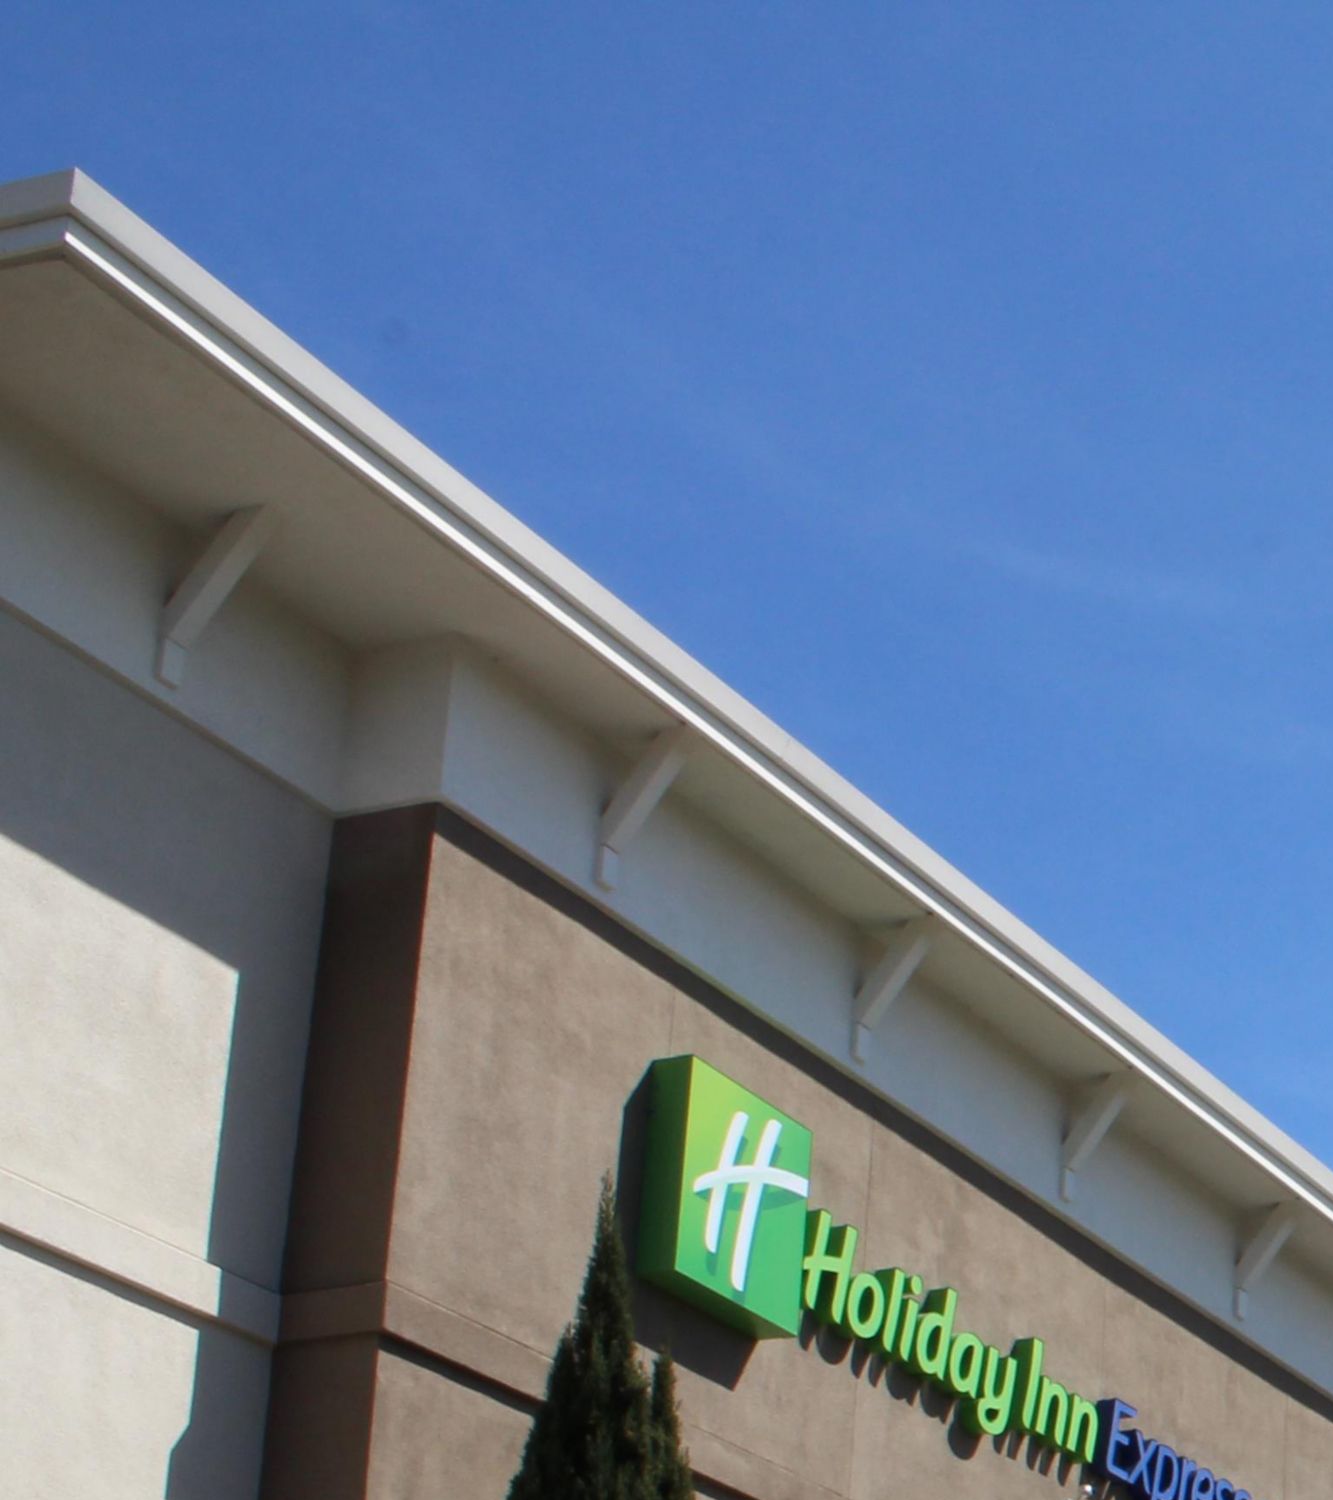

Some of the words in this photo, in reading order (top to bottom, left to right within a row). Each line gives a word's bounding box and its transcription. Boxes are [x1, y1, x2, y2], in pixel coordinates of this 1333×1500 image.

[692, 1110, 809, 1292] H
[802, 1208, 1017, 1436] Holiday
[1021, 1336, 1099, 1464] Inn
